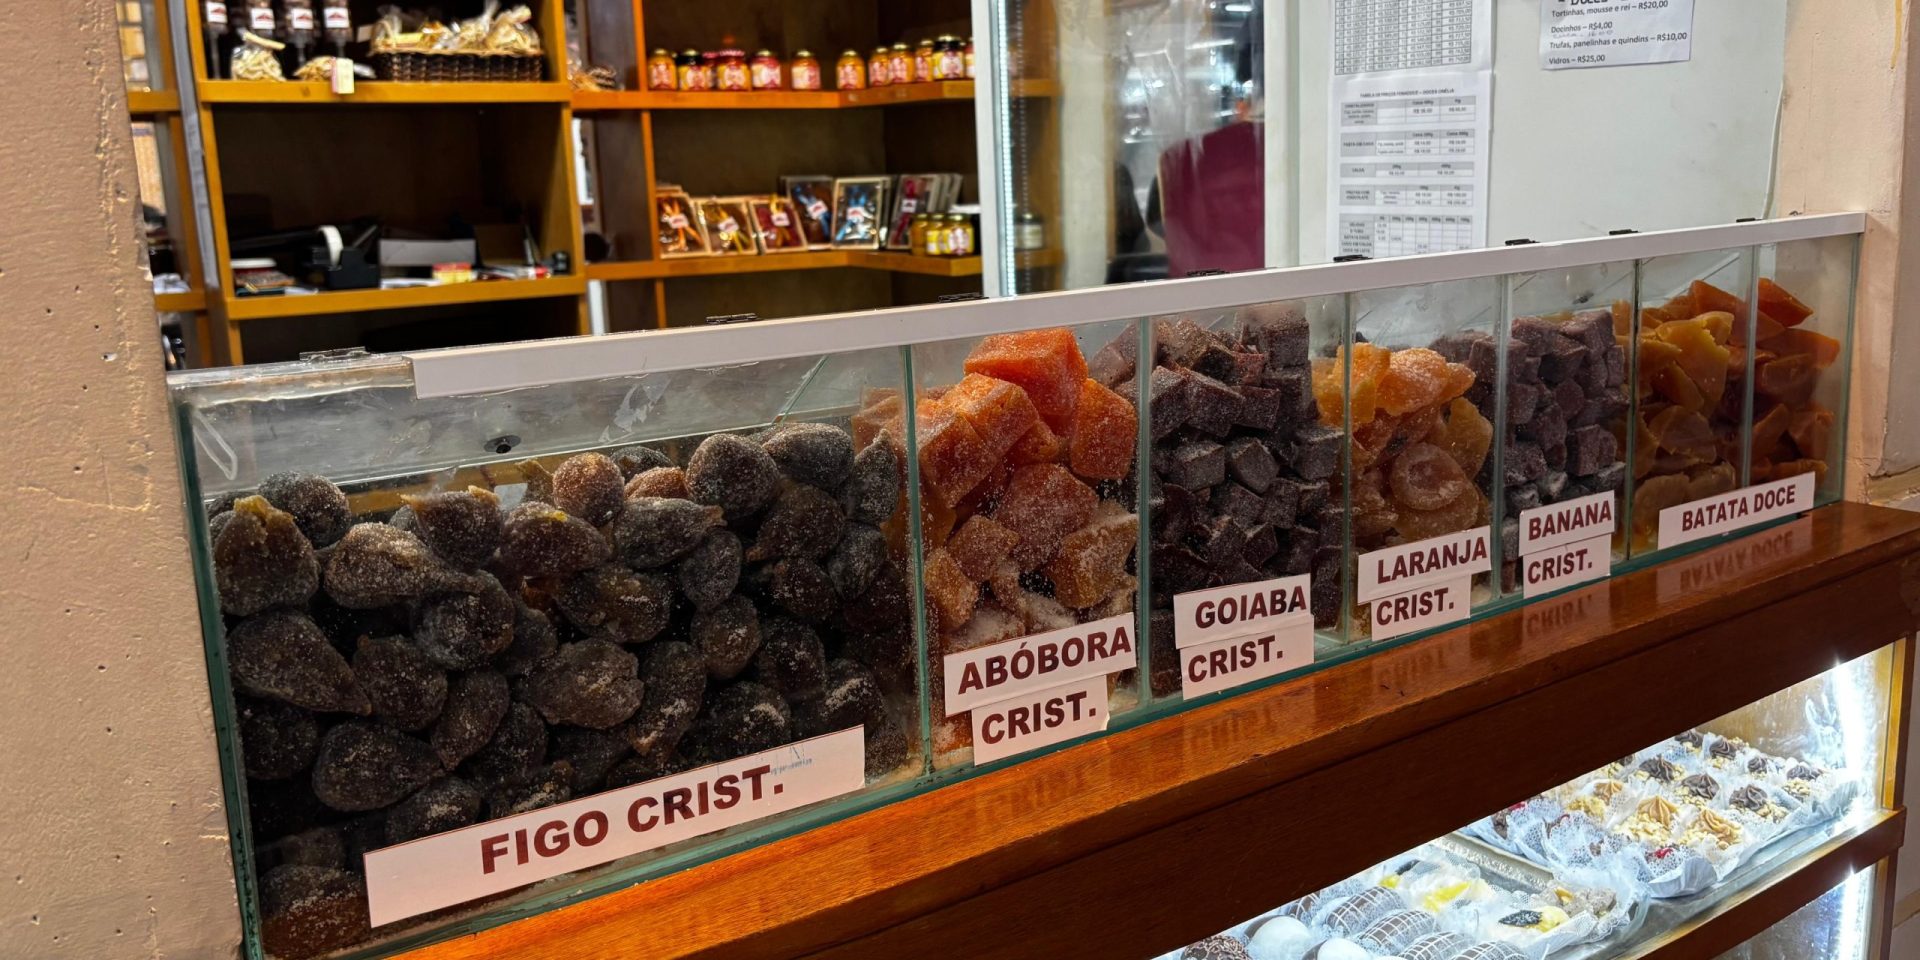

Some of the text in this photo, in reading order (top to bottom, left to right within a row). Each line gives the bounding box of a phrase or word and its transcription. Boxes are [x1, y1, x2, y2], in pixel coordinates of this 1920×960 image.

[1551, 24, 1581, 34] Docinhos
[1552, 8, 1585, 18] Tortinhas,
[1586, 6, 1613, 15] mousse
[1620, 3, 1631, 11] rei
[1638, 0, 1669, 11] R$20,00
[1549, 56, 1570, 65] Vidros
[1577, 54, 1606, 64] R$25,00
[1550, 41, 1572, 50] Trufas,
[1573, 38, 1611, 49] panelinhas
[1618, 36, 1649, 48] quindins
[1656, 32, 1688, 42] R$10,00
[1528, 501, 1612, 541] BANANA
[1682, 484, 1796, 532] BATATA DOCE
[1377, 537, 1488, 584] LARANJA
[1528, 548, 1593, 585] CRIST.
[1195, 586, 1307, 629] GOIABA
[1377, 587, 1455, 625] CRIST.
[957, 626, 1131, 695] ABÓBORA
[1188, 635, 1284, 683] CRIST.
[981, 690, 1097, 745] CRIST.
[480, 765, 784, 875] FIGO CRIST.
